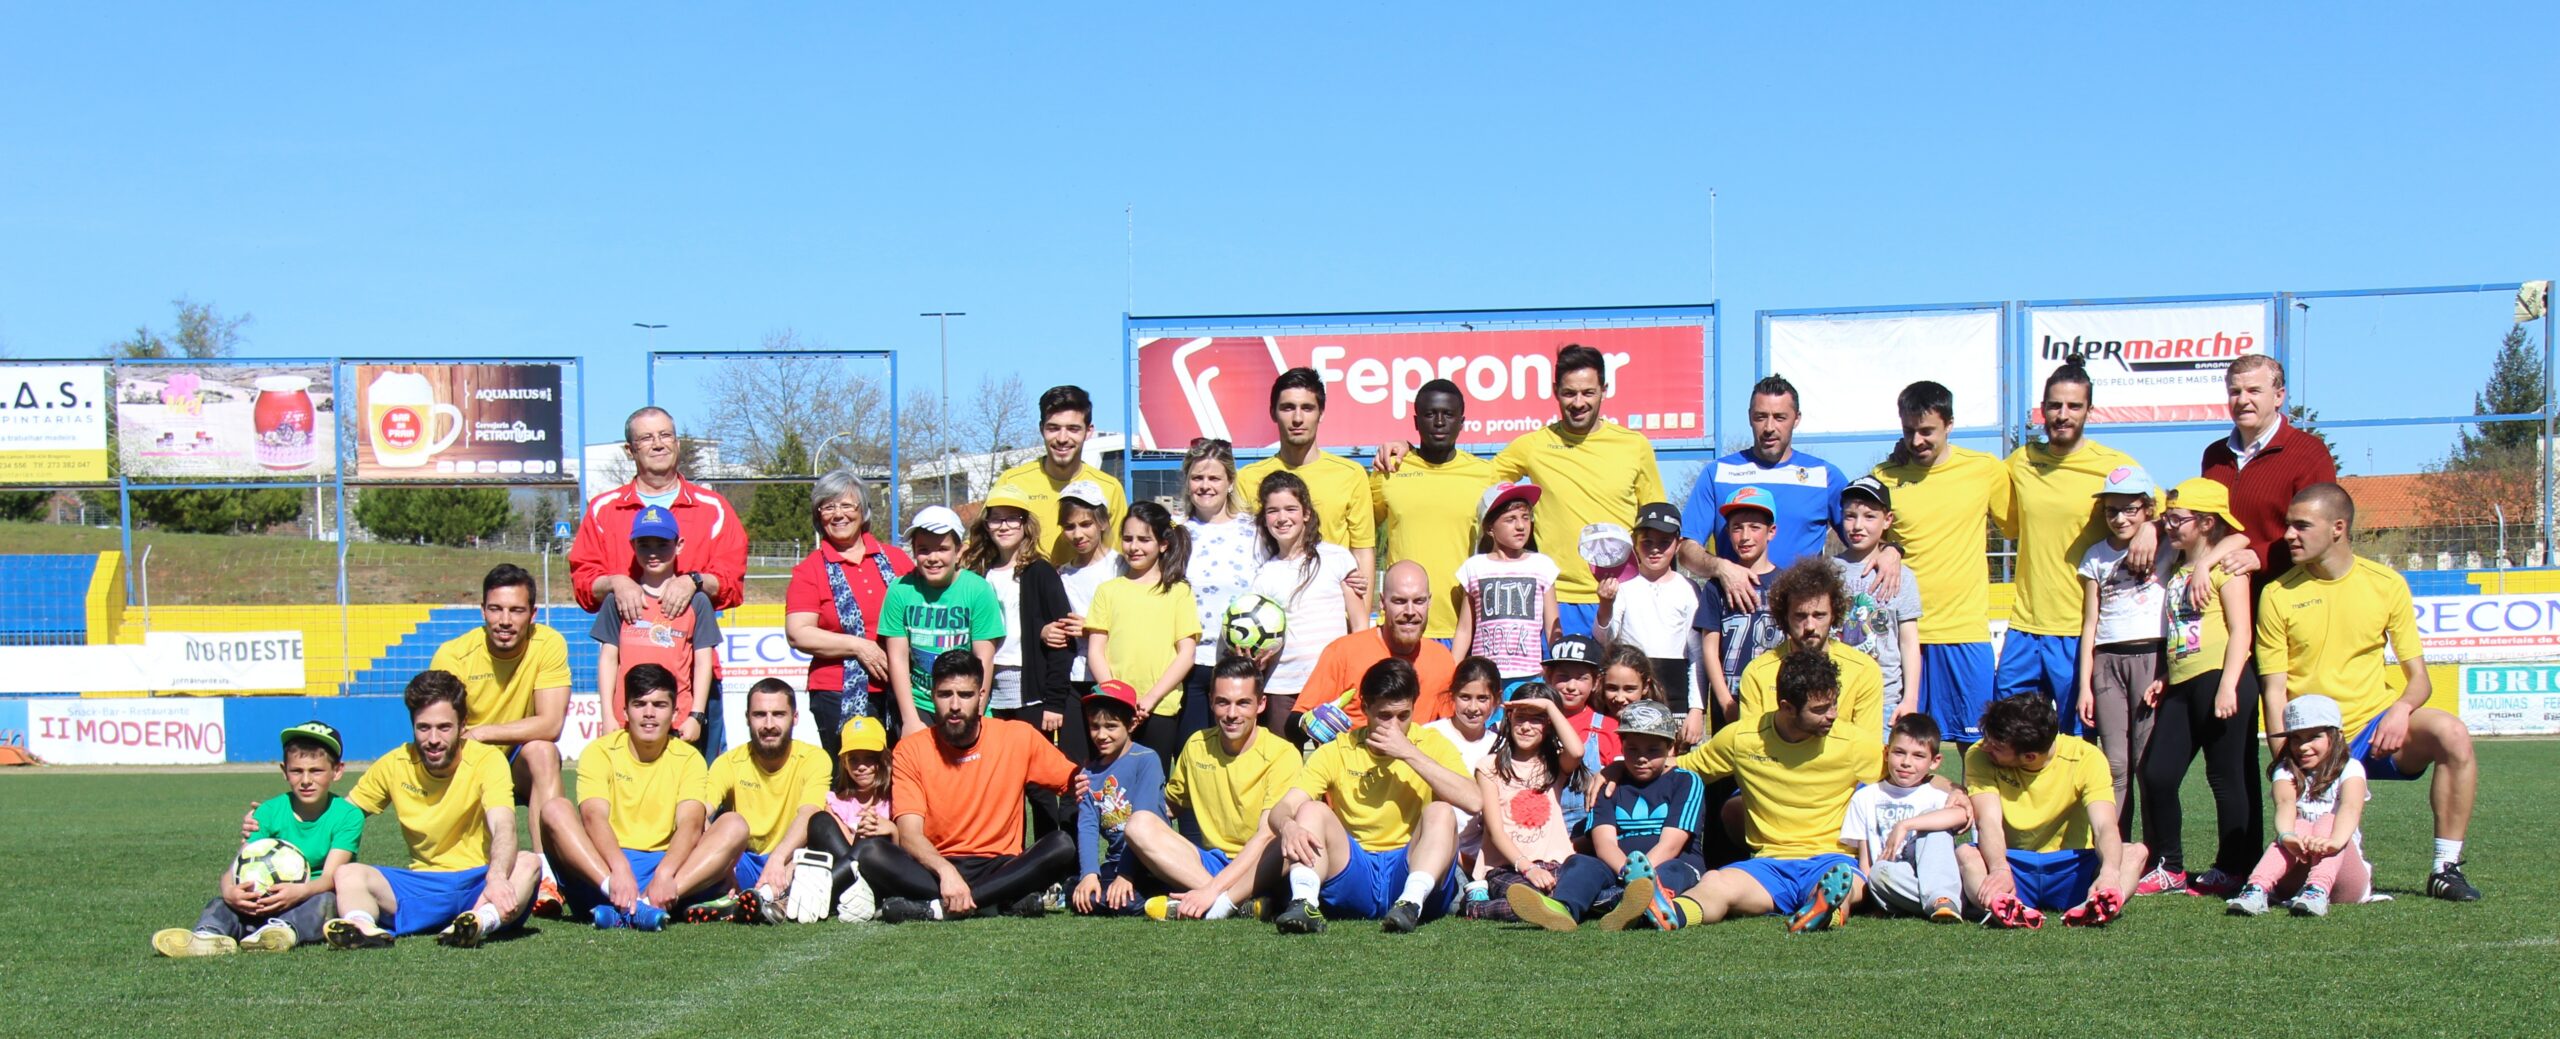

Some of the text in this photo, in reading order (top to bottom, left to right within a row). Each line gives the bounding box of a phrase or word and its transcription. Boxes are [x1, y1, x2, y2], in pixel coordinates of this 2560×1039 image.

[1312, 346, 1630, 420] Fepronr
[2111, 377, 2134, 386] PELO
[2137, 376, 2175, 385] MELHOR
[2177, 376, 2183, 384] E
[2185, 375, 2208, 384] MAIS
[475, 388, 539, 402] AQUARIUS
[1486, 417, 1542, 437] pronto
[1483, 581, 1533, 616] CITY
[185, 638, 303, 662] NORDESTE
[719, 633, 812, 663] EC
[1481, 624, 1529, 656] ROCK
[2460, 637, 2476, 646] de
[2479, 636, 2534, 646] Materiais
[2537, 635, 2553, 644] de
[1551, 641, 1586, 660] NYC
[721, 666, 809, 676] ércio de Materia
[566, 700, 601, 716] PAS
[39, 716, 224, 755] II MODERNO
